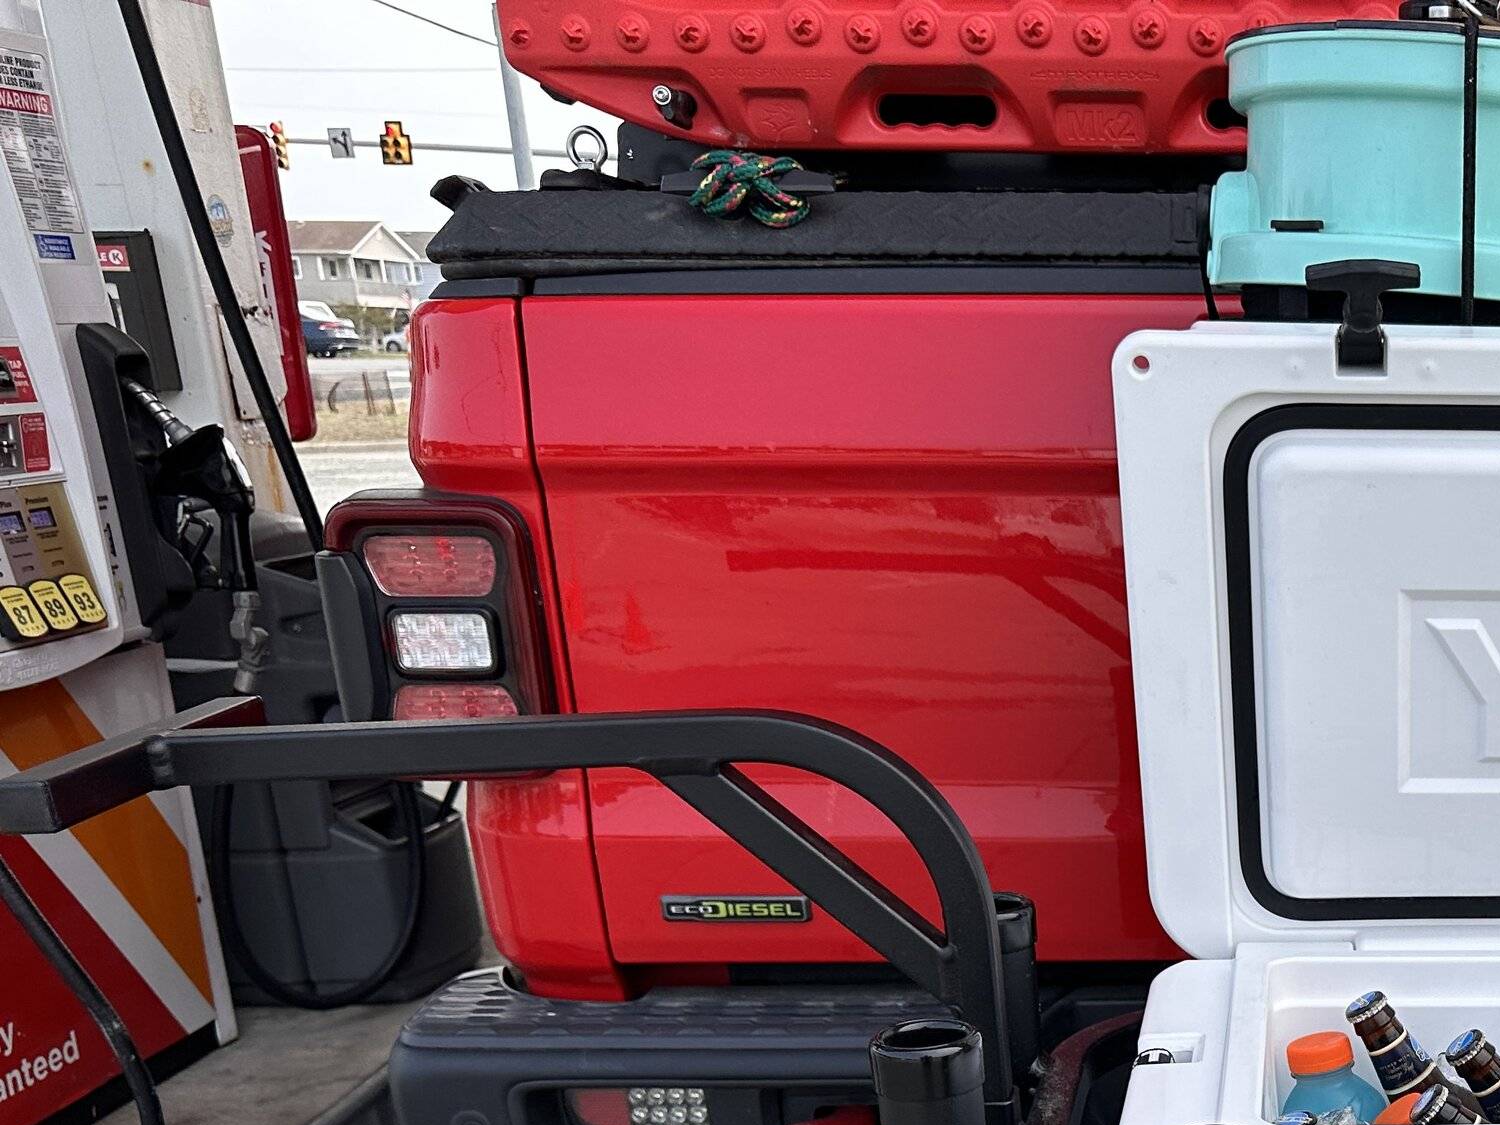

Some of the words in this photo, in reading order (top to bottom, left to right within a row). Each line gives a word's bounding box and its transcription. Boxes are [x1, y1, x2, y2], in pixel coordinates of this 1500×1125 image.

[44, 598, 67, 618] 89
[74, 591, 96, 611] 93
[13, 605, 35, 626] 87
[0, 1030, 80, 1103] anteed
